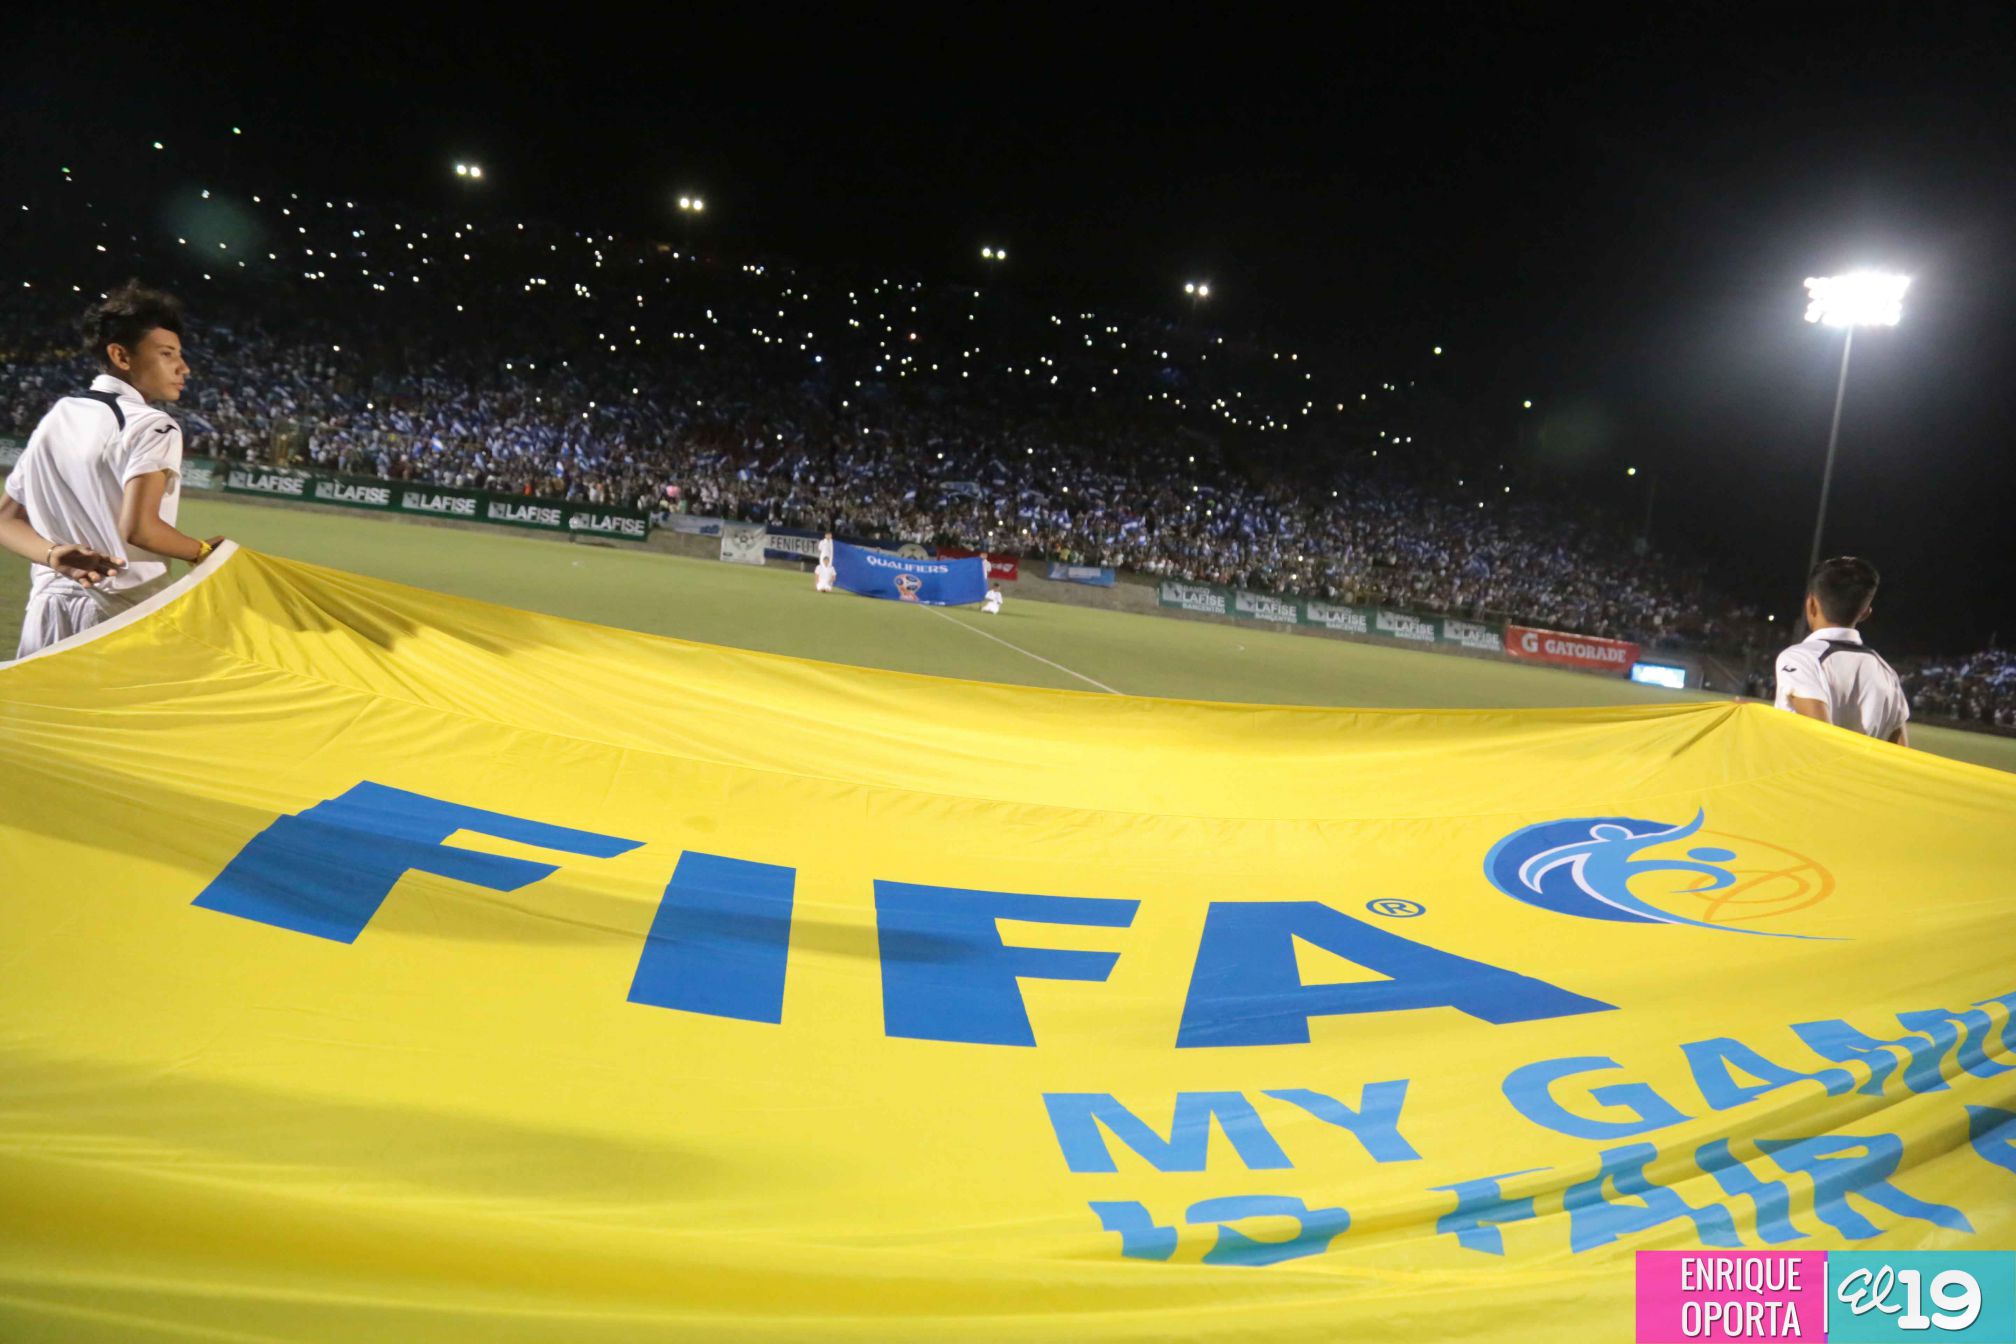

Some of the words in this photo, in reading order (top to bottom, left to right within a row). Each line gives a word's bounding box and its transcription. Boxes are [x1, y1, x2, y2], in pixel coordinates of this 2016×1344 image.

[246, 474, 304, 494] LAFISE
[333, 484, 391, 504] LAFISE
[420, 494, 476, 514] LAFISE
[506, 505, 561, 524] LAFISE
[591, 514, 646, 535] LAFISE
[770, 536, 817, 553] FENIFUT
[866, 554, 949, 574] QUALIFIERS
[1182, 591, 1225, 607] LAFISE
[1255, 600, 1297, 616] LAFISE
[1326, 611, 1367, 626] LAFISE
[1395, 620, 1434, 635] LAFISE
[1461, 629, 1500, 644] LAFISE
[1521, 632, 1539, 653] G
[1545, 639, 1627, 663] GATORADE
[190, 779, 1622, 1049] FIFA
[1041, 1079, 1423, 1173] MY
[1424, 1133, 1977, 1256] FAIR
